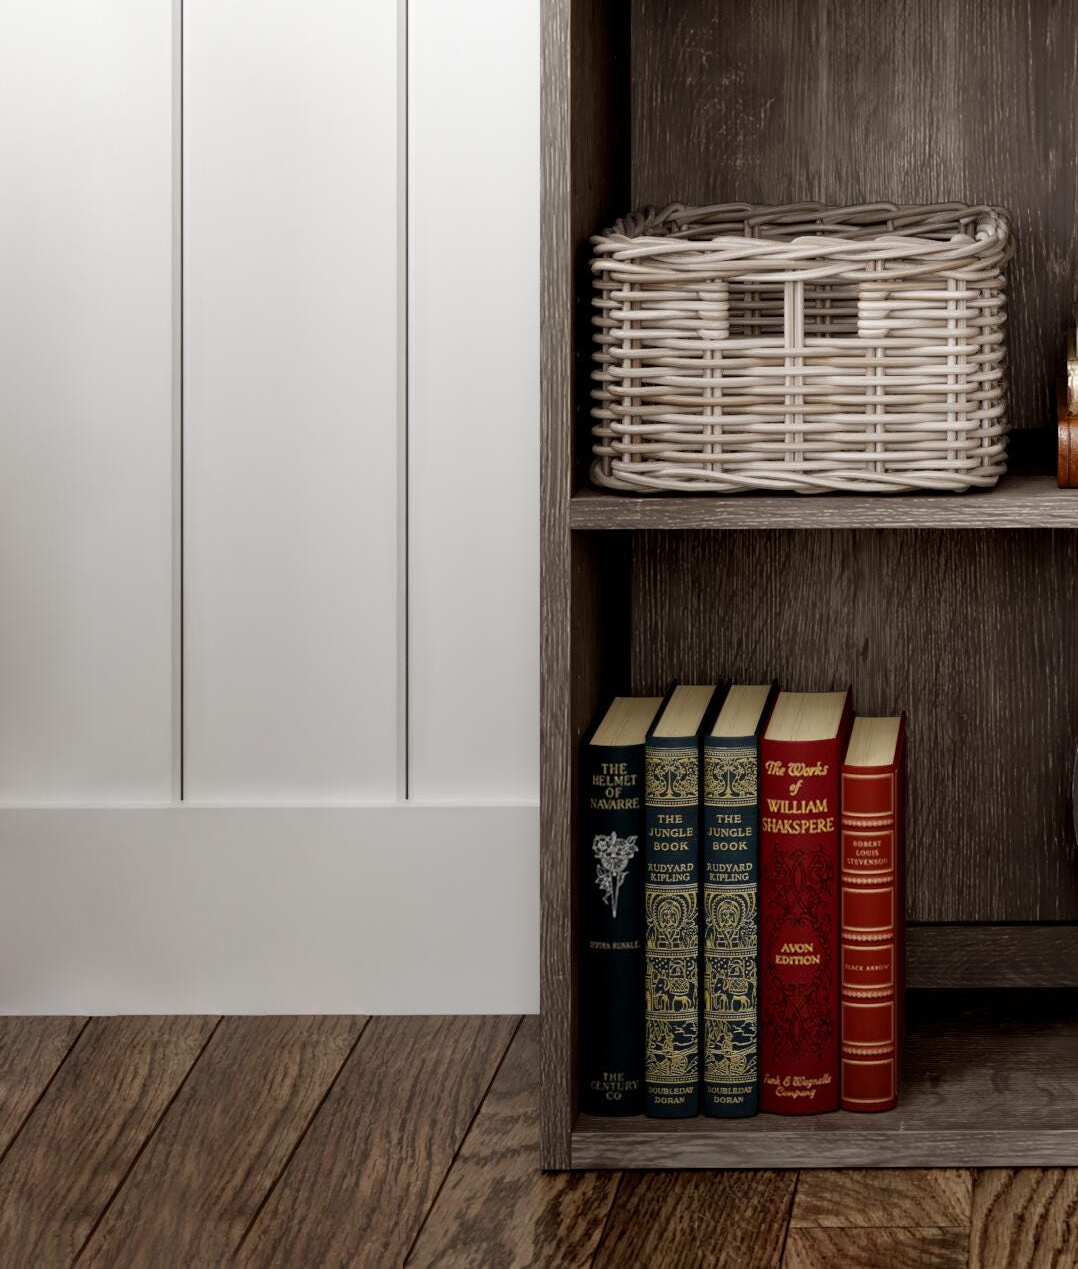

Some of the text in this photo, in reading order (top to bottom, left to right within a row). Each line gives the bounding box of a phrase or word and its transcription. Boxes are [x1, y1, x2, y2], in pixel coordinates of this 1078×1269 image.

[601, 763, 628, 775] THE
[765, 761, 829, 777] The Works
[592, 774, 637, 787] HELMET
[605, 787, 622, 798] OF
[789, 779, 804, 796] of
[590, 798, 640, 810] NAVARRE
[766, 798, 828, 814] WILLIAM
[657, 814, 683, 824] THE
[716, 814, 742, 824] THE
[762, 817, 835, 834] SHAKSPERE
[649, 827, 694, 838] JUNGLE
[707, 827, 753, 838] JUNGLE
[653, 842, 689, 851] BOOK
[712, 842, 748, 851] BOOK
[852, 840, 882, 848] ROBERT
[855, 849, 880, 857] LOUIS
[648, 862, 694, 872] RUDYARD
[707, 862, 753, 872] RUDYARD
[847, 858, 889, 866] STEVENSON
[651, 873, 691, 883] KIPLING
[709, 873, 750, 883] KIPLING
[781, 943, 814, 953] AVON
[775, 954, 821, 966] EDITION
[602, 1072, 625, 1081] THE
[590, 1080, 639, 1091] CENTURY
[648, 1086, 694, 1095] DOUBLEDAY
[707, 1086, 753, 1095] DOUBLEDAY
[606, 1091, 622, 1100] CO
[775, 1087, 817, 1099] Company
[654, 1096, 686, 1105] DORAN
[713, 1096, 745, 1105] DORAN
